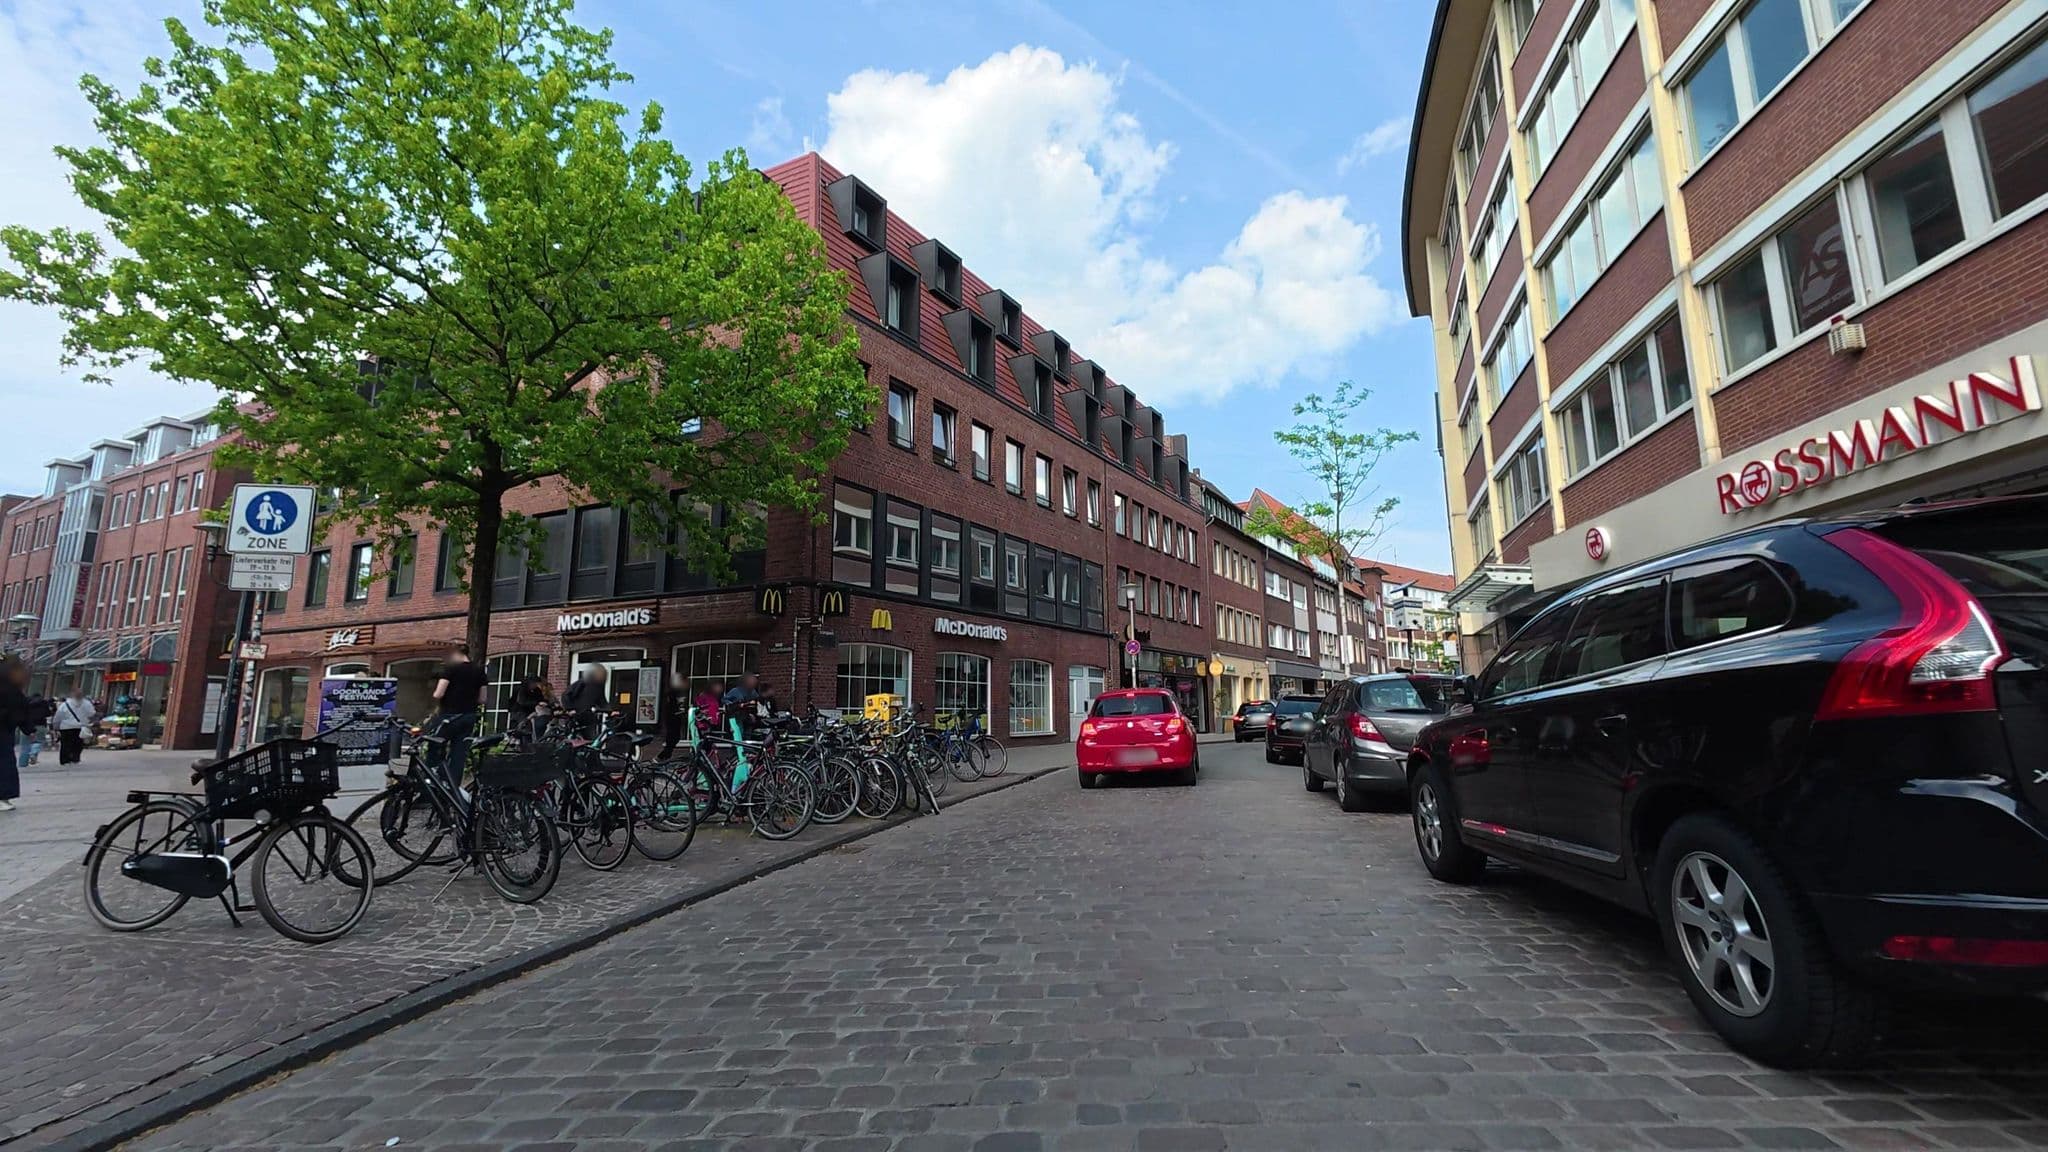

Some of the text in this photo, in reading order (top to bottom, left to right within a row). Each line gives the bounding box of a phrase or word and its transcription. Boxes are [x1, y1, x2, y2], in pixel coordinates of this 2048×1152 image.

[1716, 354, 2041, 514] ROSSMANN
[247, 537, 288, 549] ZONE
[557, 608, 651, 632] McDonald's
[934, 617, 1008, 641] McDonald's
[332, 688, 387, 696] DOCKLANDS
